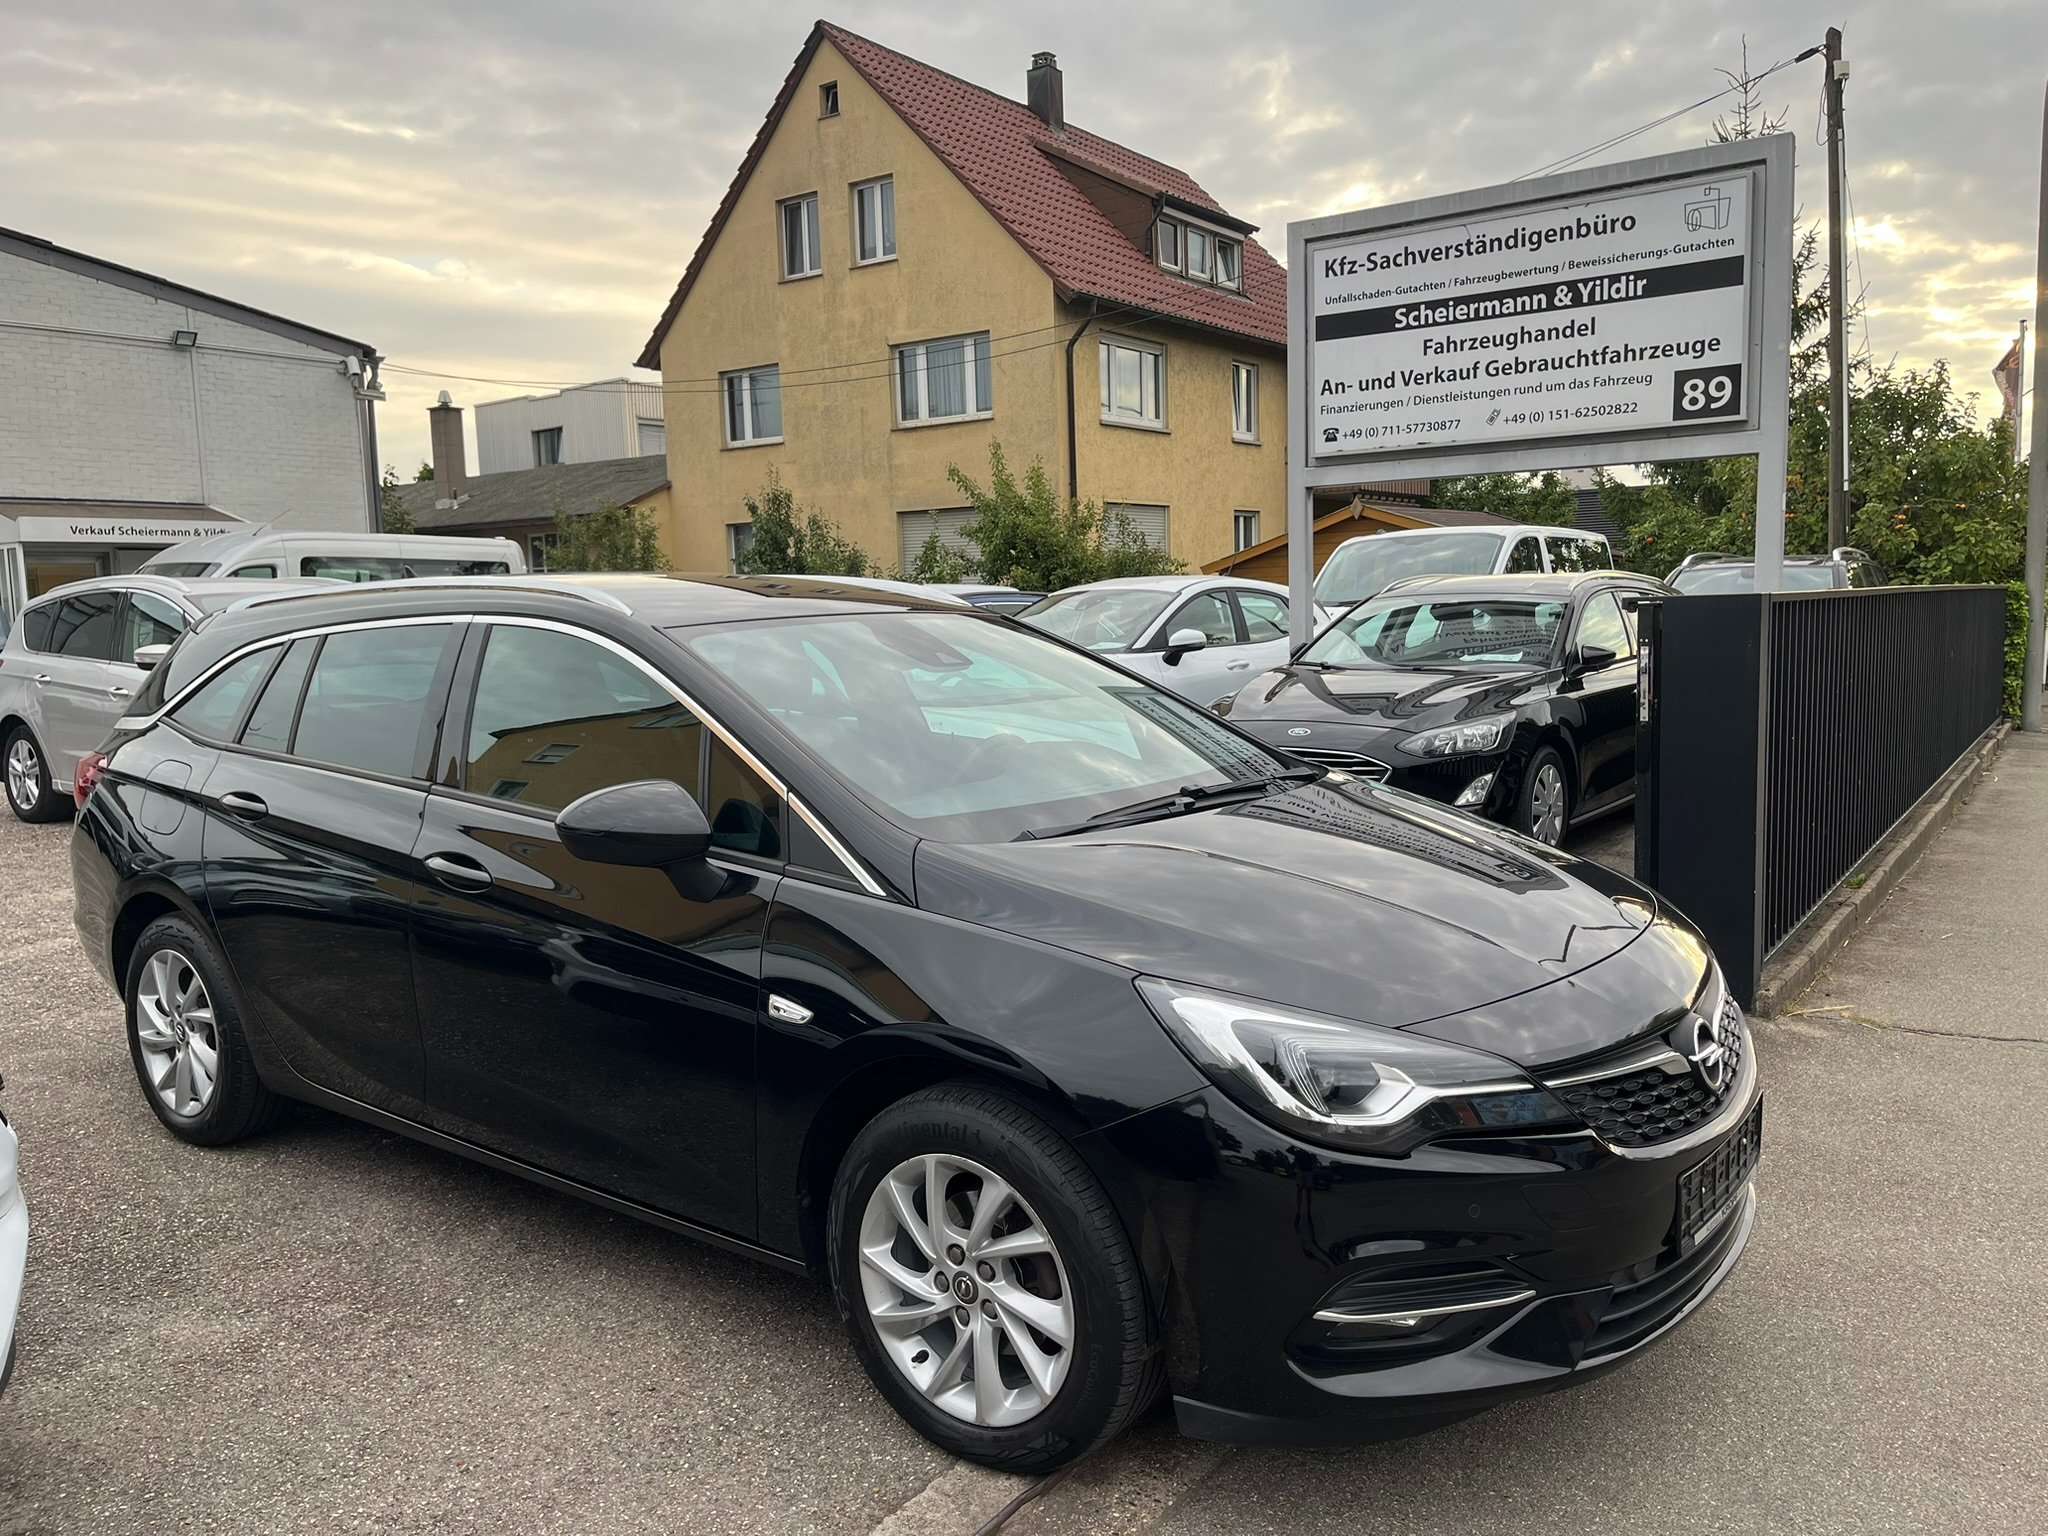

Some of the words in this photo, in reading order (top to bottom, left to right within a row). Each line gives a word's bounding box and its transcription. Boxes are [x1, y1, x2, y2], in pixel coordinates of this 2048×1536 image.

[1324, 213, 1637, 278] Kfz-Sachverständigenbüro
[1324, 280, 1446, 305] Unfallschaden-Gutachten
[1453, 265, 1559, 287] Fahrzeugbewertung
[1568, 237, 1735, 270] Beweissicherungs-Gutachten
[1394, 293, 1547, 329] Scheiermann
[1553, 285, 1573, 307] &
[1577, 274, 1648, 302] Yildir
[1422, 316, 1596, 356] Fahrzeughandel
[1320, 379, 1353, 396] An-
[1358, 370, 1396, 392] und
[1400, 360, 1481, 387] Verkauf
[1485, 337, 1721, 377] Gebrauchtfahrzeuge
[1320, 399, 1404, 415] Finanzierungen
[1413, 388, 1511, 406] Dienstleistungen
[1514, 382, 1543, 395] rund
[1546, 382, 1565, 393] um
[1568, 377, 1590, 390] das
[1593, 373, 1653, 388] Fahrzeug
[1503, 412, 1526, 425] +49
[1528, 411, 1544, 424] (0)
[1548, 402, 1639, 421] 151-62502822
[1681, 375, 1733, 412] 89
[1342, 429, 1363, 440] +49
[1364, 427, 1379, 440] (0)
[1382, 419, 1461, 437] 711-57730877
[70, 525, 116, 536] Verkauf
[118, 526, 191, 537] Scheiermann
[193, 527, 202, 537] &
